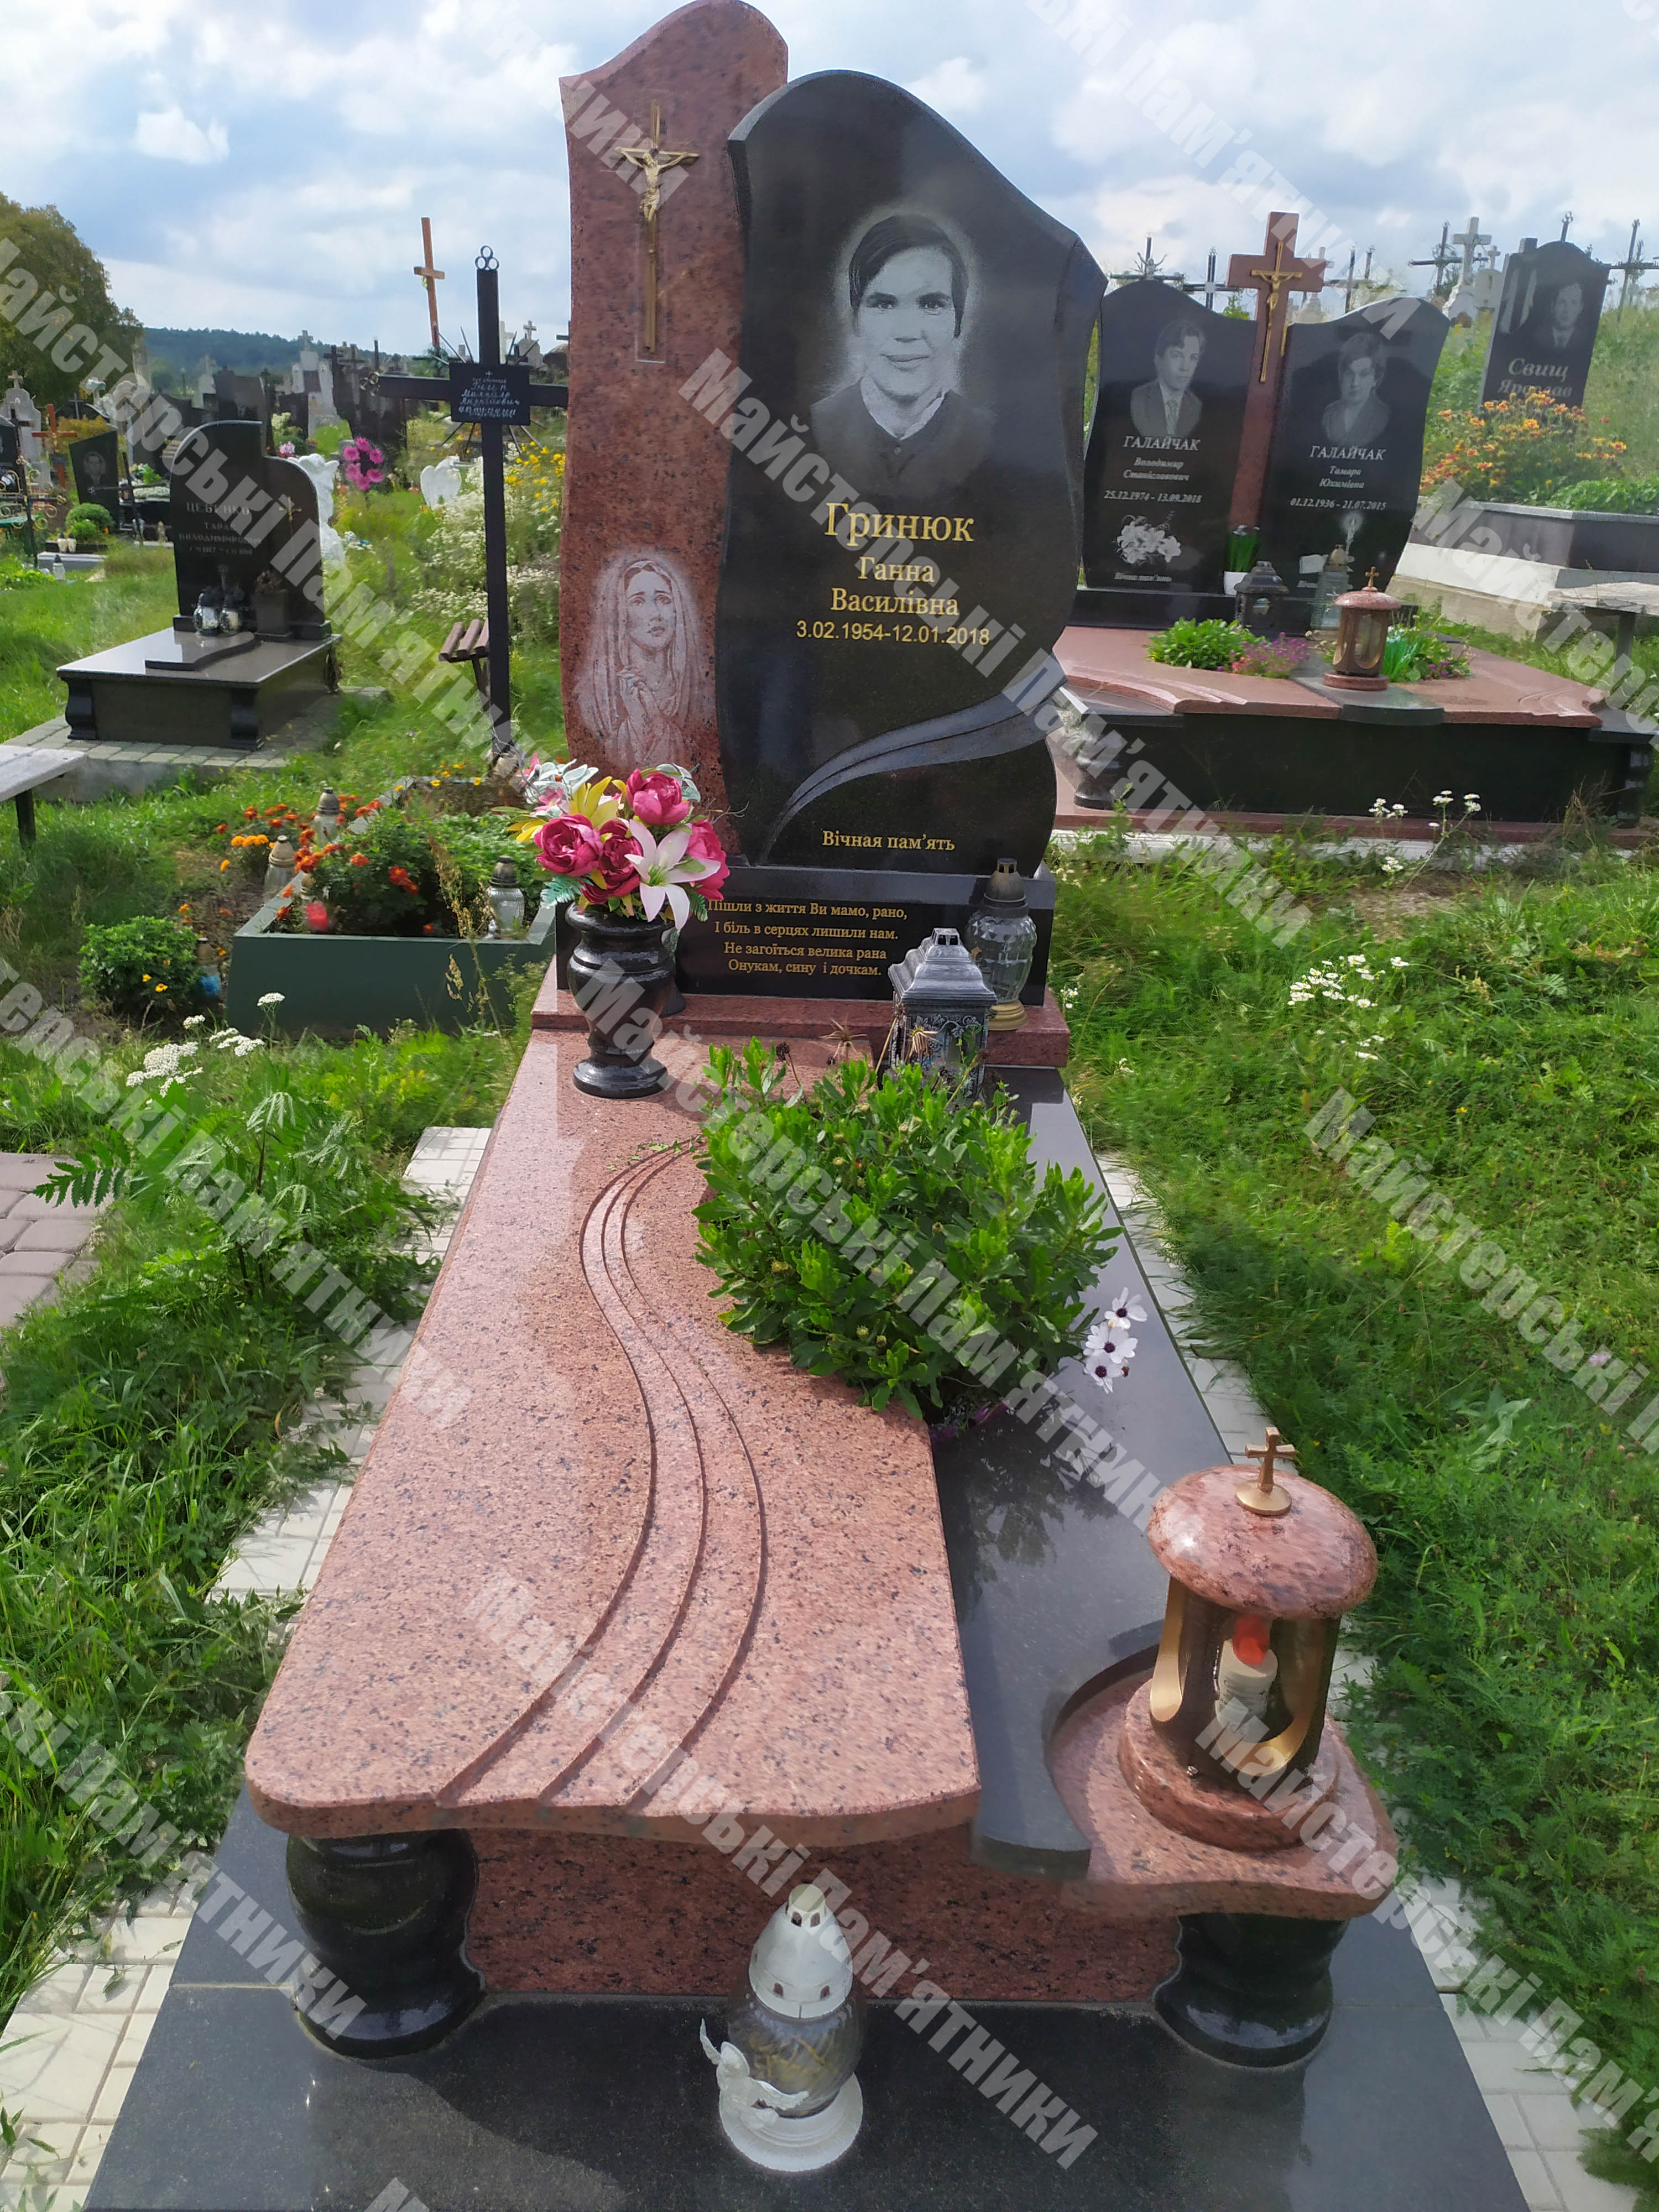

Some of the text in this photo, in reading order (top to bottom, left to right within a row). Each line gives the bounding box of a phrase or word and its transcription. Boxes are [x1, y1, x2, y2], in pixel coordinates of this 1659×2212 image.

[1123, 435, 1201, 451] ГАЛАЙЧАК
[1310, 445, 1386, 460] ГАЛАЙЧАК
[1329, 465, 1361, 477] Тамара
[825, 503, 974, 546] Гринюк
[858, 556, 935, 583] Ганна
[830, 587, 959, 615] Василівна
[796, 620, 990, 645] 3.02.1954-12.01.2018
[822, 831, 955, 852] Вічная пам'ять
[708, 899, 907, 920] Пішли з життя Ви мамо, рано,
[714, 921, 899, 940] І біль в серцях лишили нам.
[724, 942, 887, 961] Не загоїться велика рана
[728, 958, 881, 975] Онукам, сину і дочкам.
